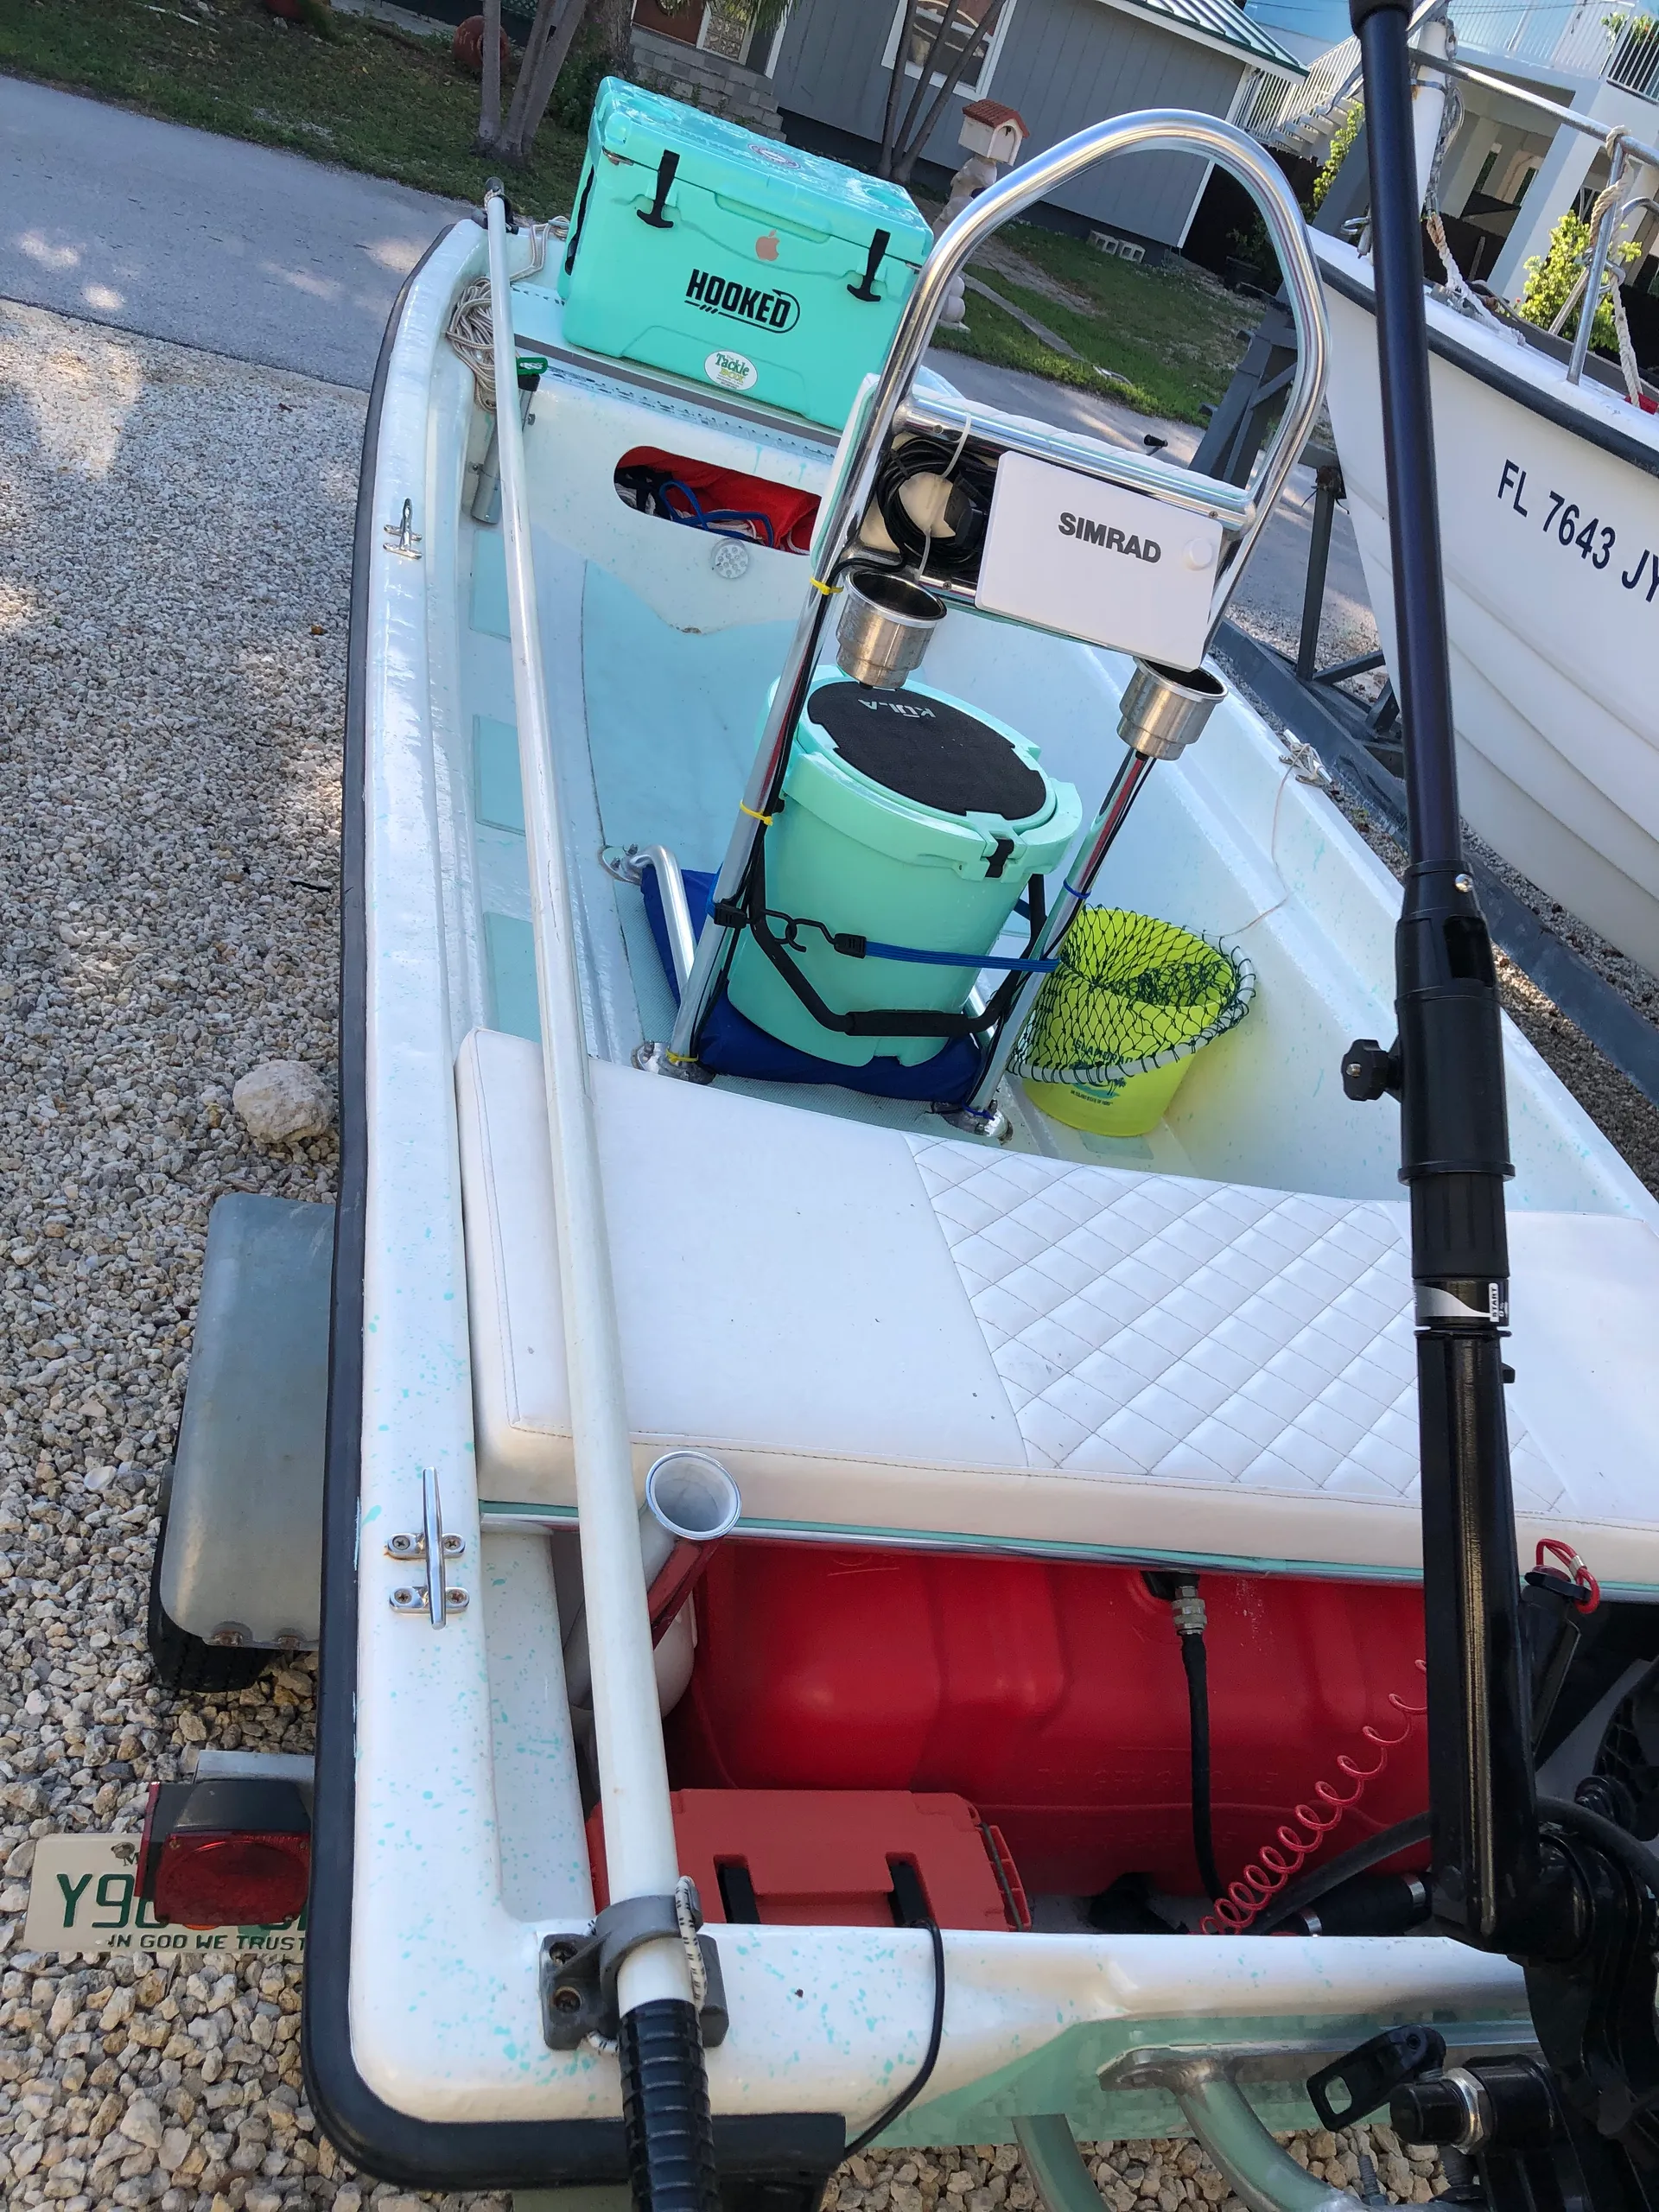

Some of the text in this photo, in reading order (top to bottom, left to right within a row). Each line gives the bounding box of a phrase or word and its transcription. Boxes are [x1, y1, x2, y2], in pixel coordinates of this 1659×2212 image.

[685, 268, 791, 328] HOOKED
[715, 353, 750, 377] Tackle
[1058, 512, 1161, 563] SIMRAD
[1497, 459, 1659, 603] FL 7643 JY
[139, 1934, 188, 1948] GOD
[195, 1934, 228, 1949] WE
